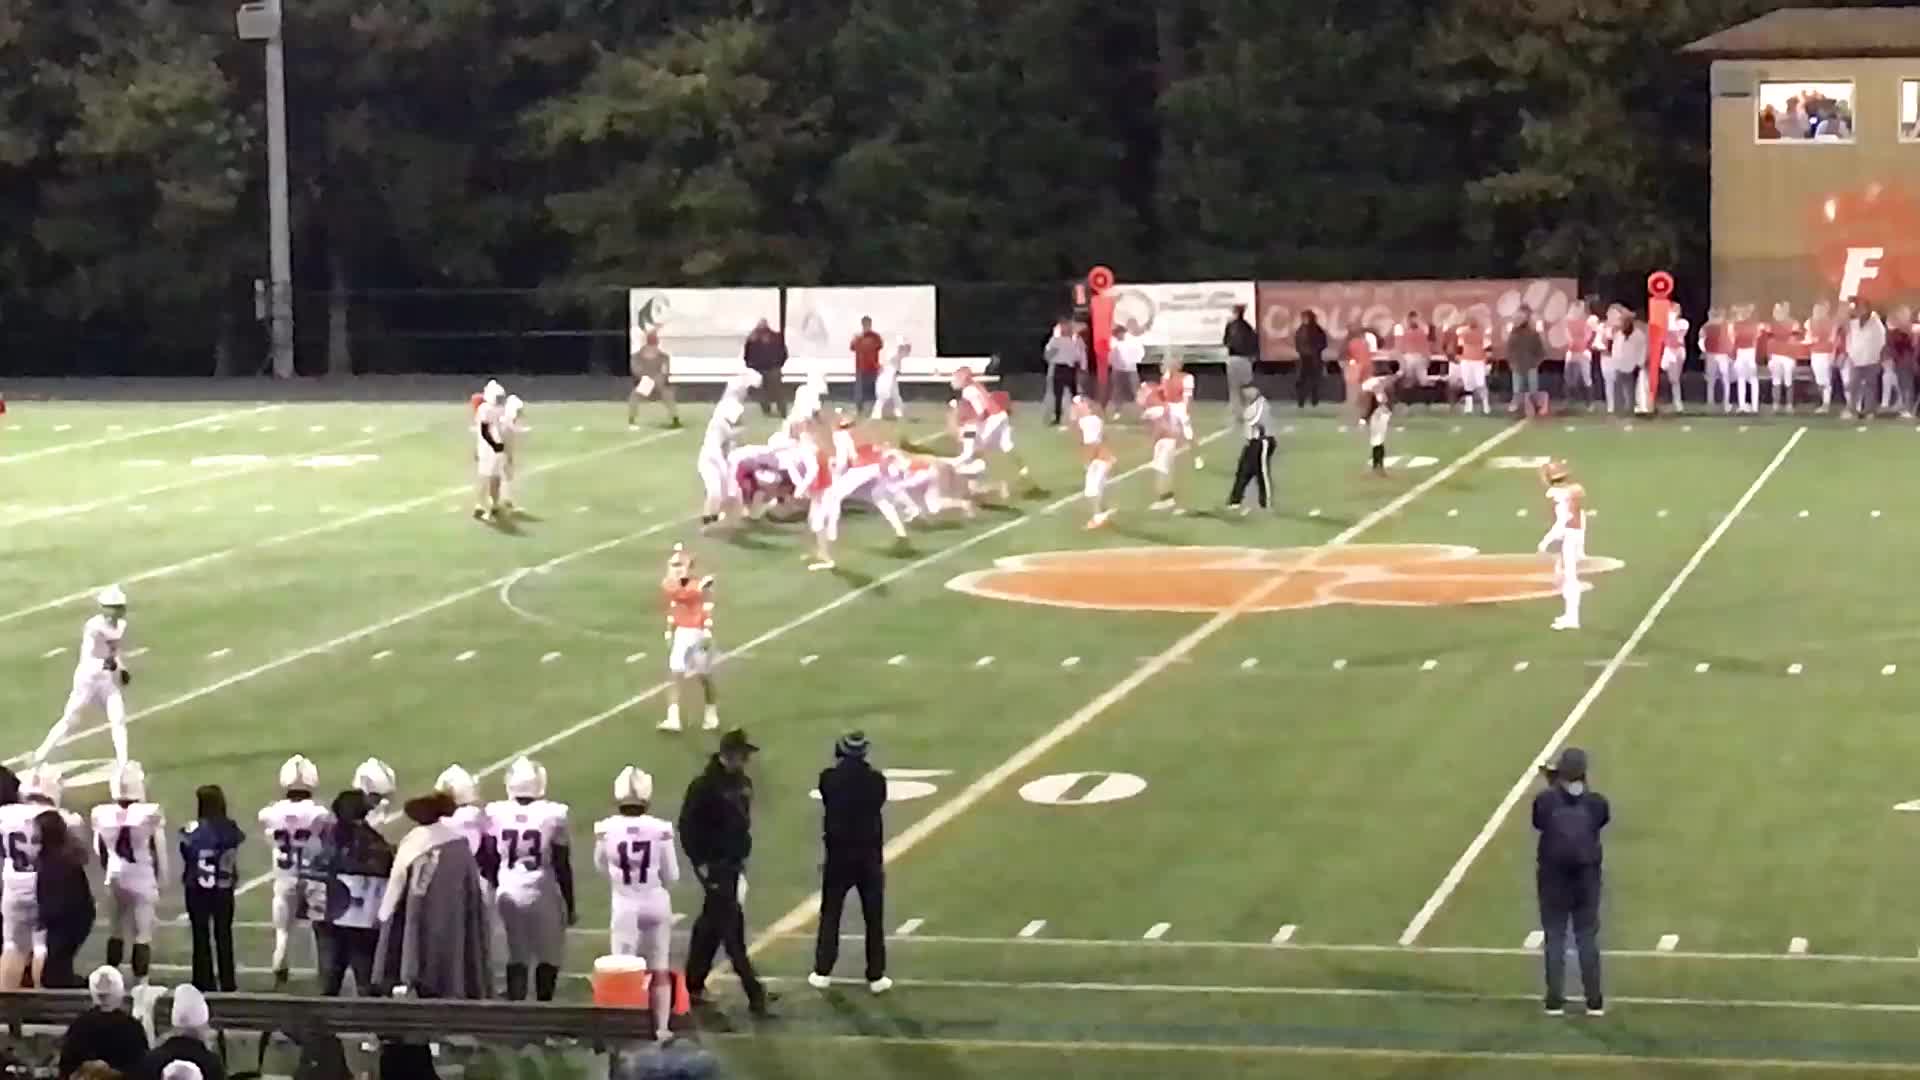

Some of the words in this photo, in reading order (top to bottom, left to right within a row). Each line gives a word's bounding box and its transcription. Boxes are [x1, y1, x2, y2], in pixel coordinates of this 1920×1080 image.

[1262, 304, 1492, 339] COUGRS
[502, 829, 542, 870] 73
[617, 841, 651, 885] 17
